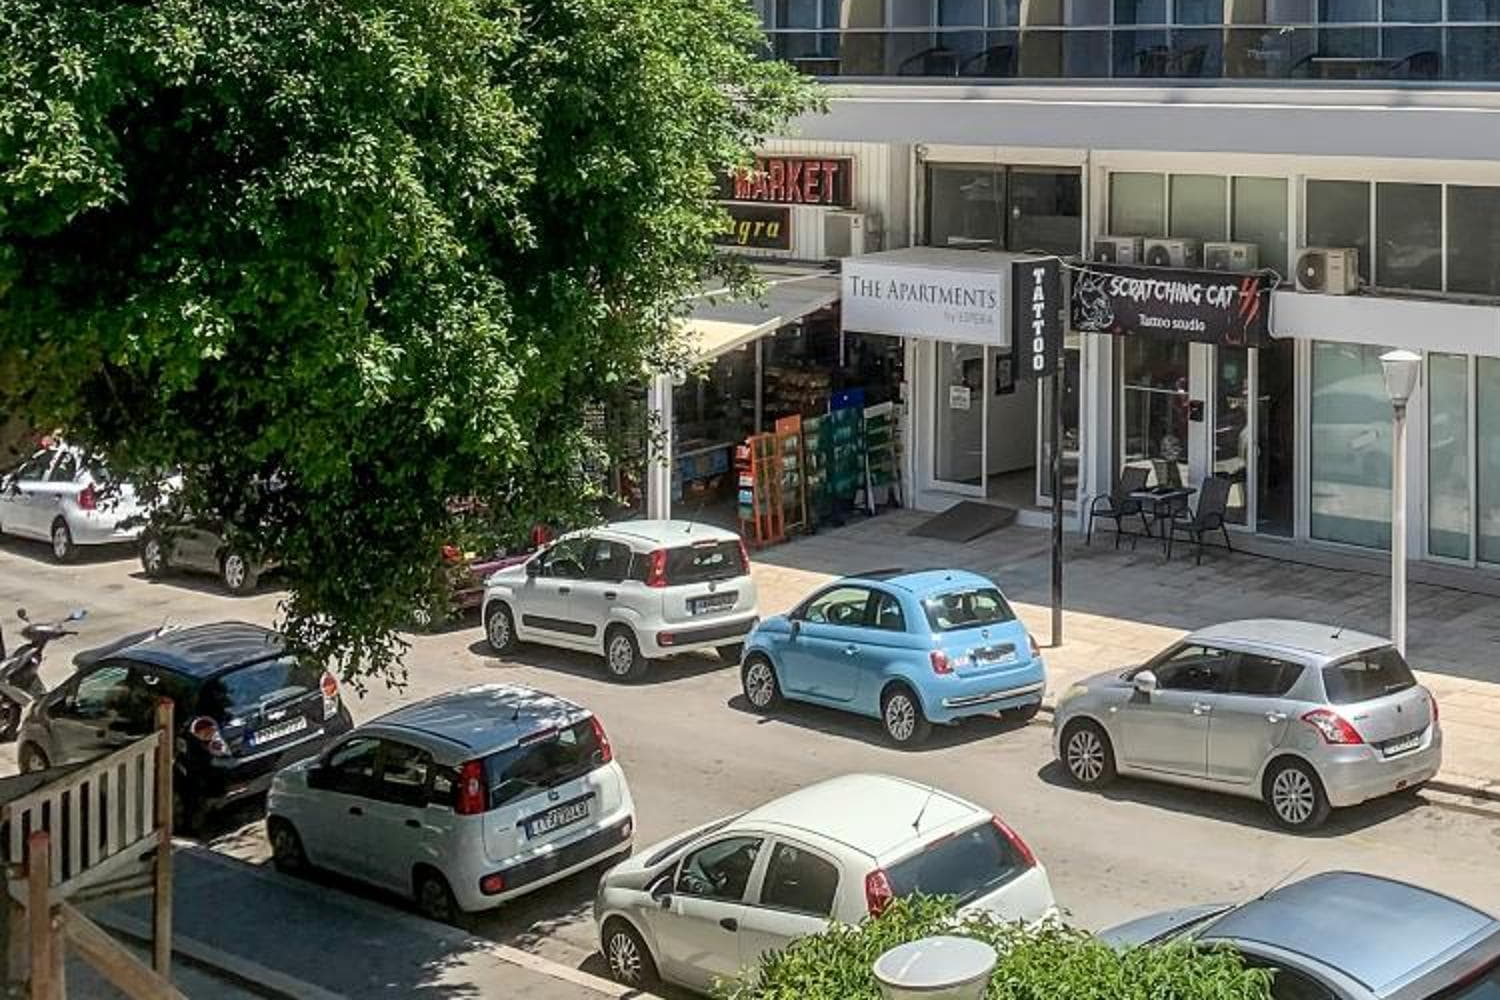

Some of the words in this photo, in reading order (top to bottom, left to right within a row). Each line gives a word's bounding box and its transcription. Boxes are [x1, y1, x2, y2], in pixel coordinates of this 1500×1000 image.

[734, 157, 838, 203] MARKET
[849, 274, 882, 298] THE
[886, 279, 998, 310] APARTMENTS
[1110, 276, 1201, 305] SCRATCHING
[1205, 284, 1238, 310] CAT
[1032, 267, 1046, 371] TATTOO
[1138, 313, 1171, 330] Tattoo
[1172, 317, 1206, 332] studio
